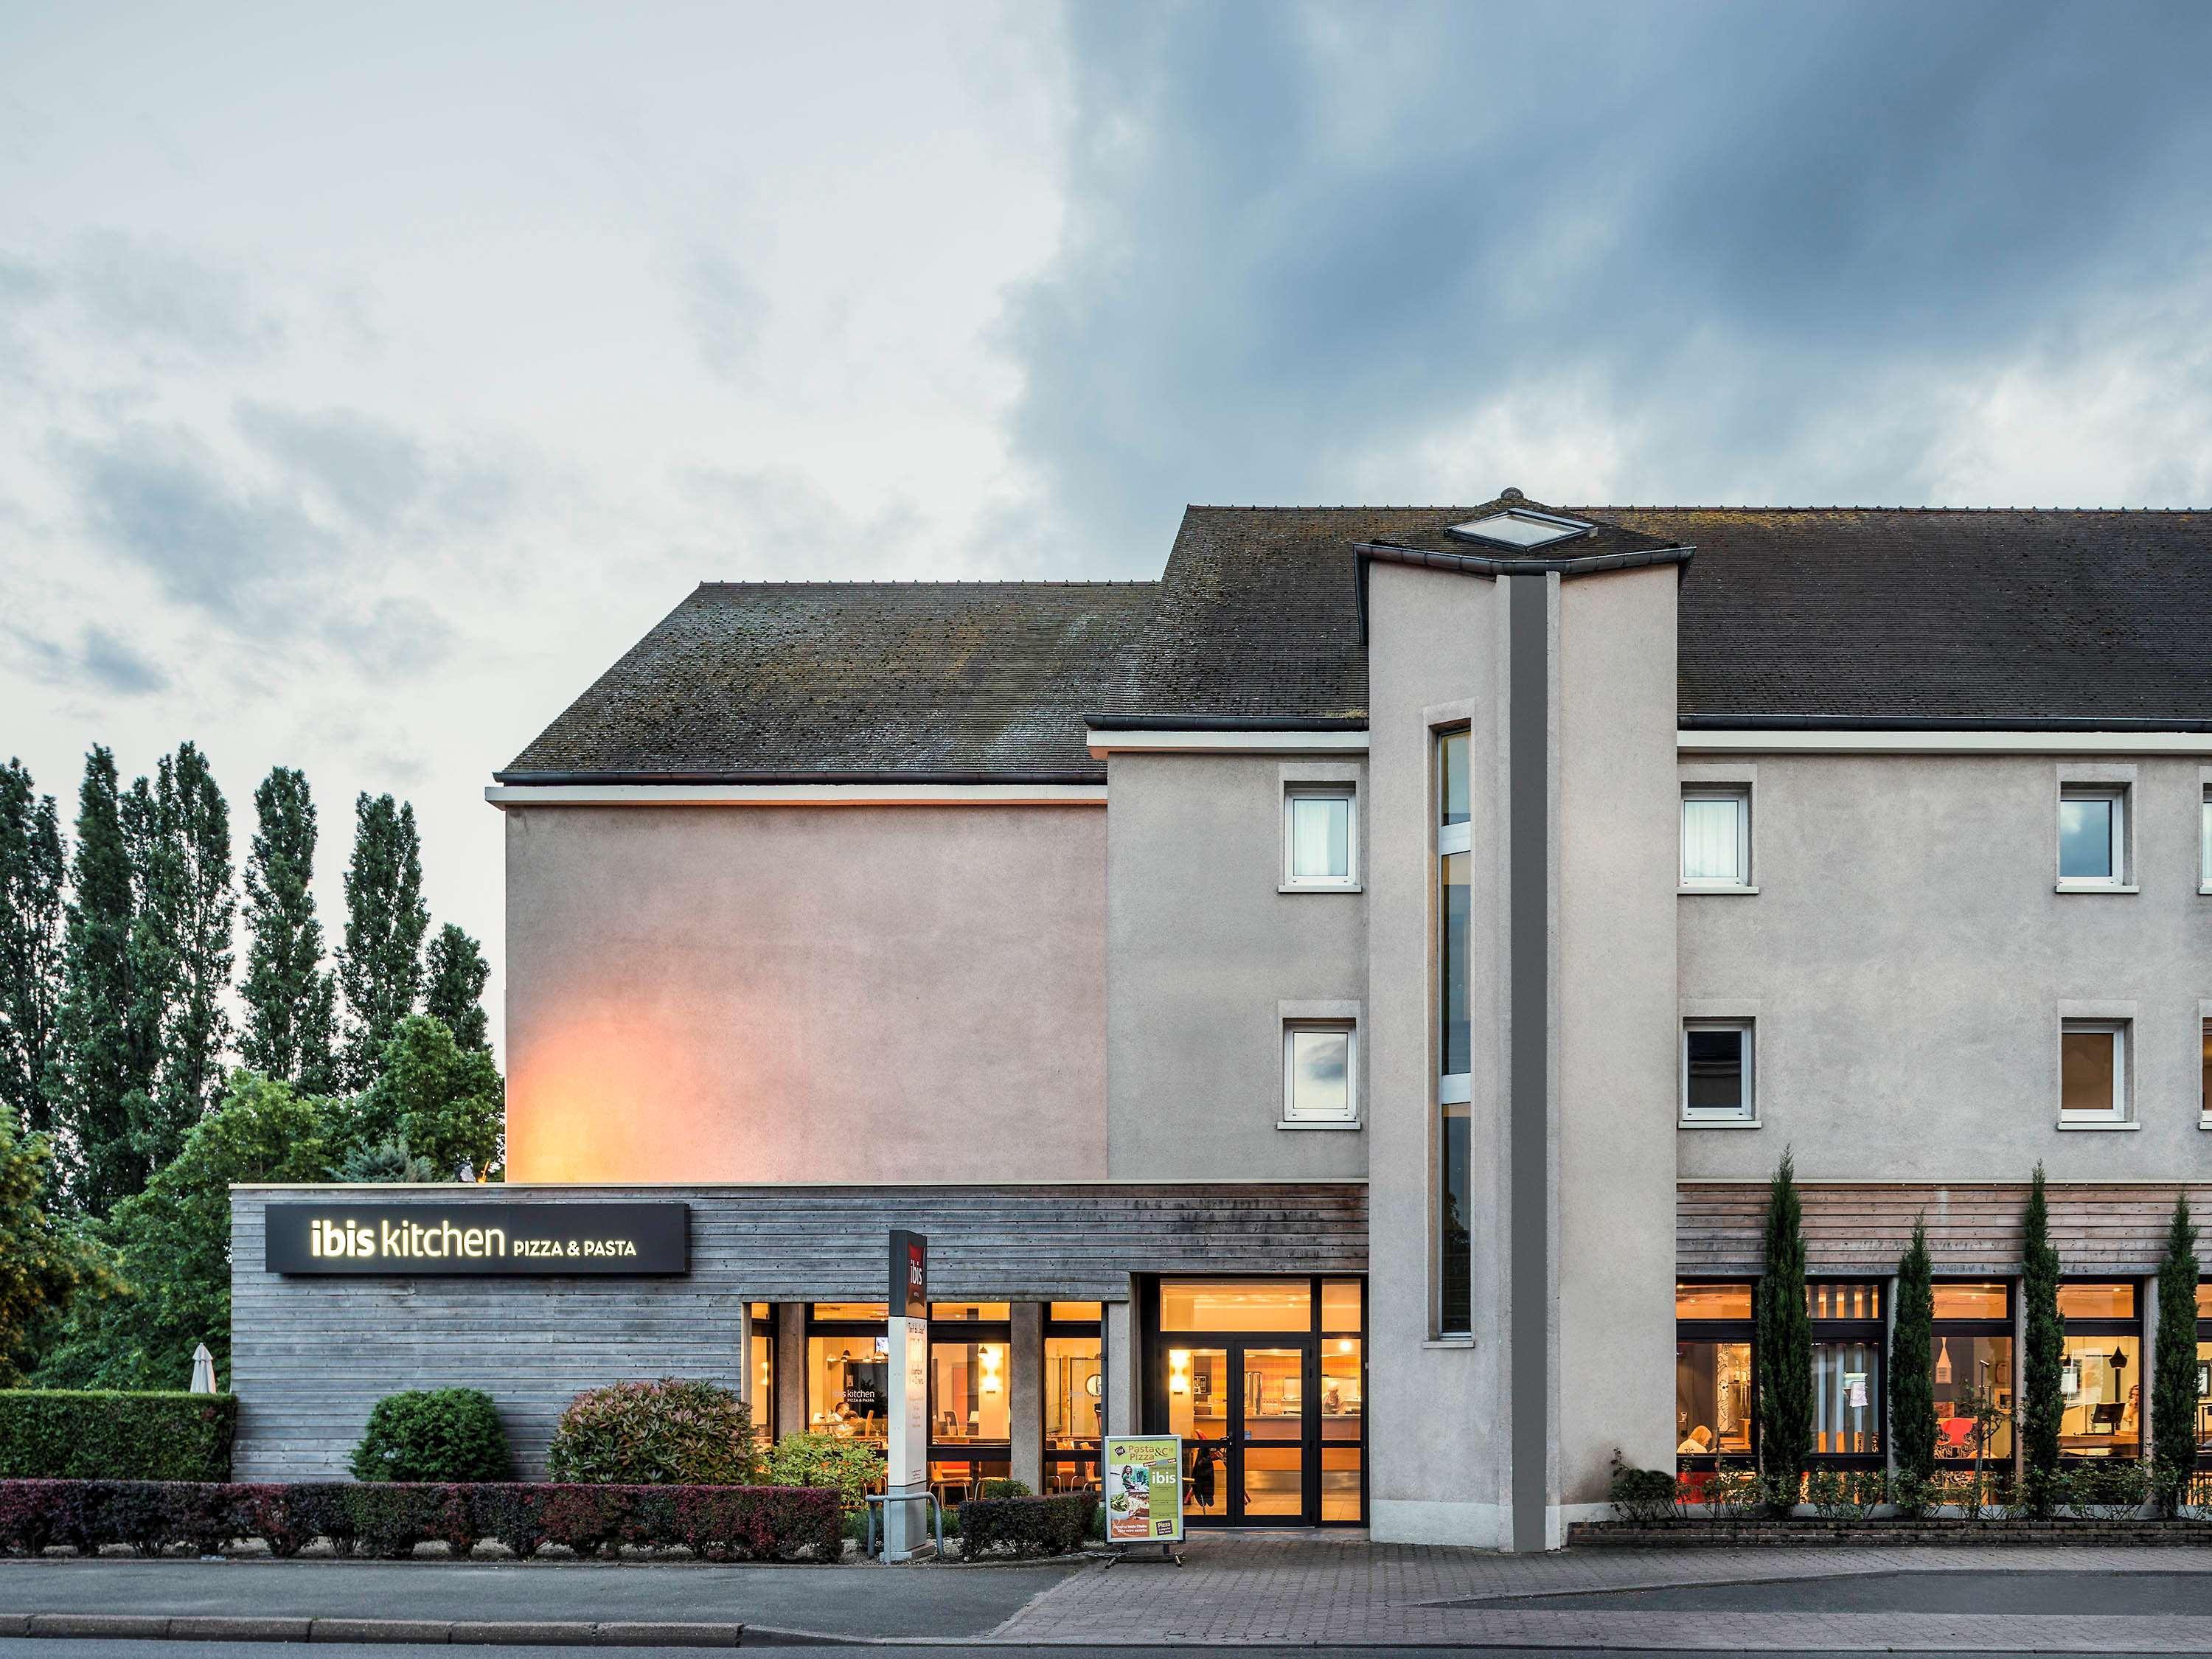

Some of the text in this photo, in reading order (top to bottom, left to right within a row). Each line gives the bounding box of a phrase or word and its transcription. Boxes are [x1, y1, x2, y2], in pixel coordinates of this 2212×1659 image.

[311, 1220, 637, 1257] ibis kitchen PIZZA & PASTA
[911, 1259, 922, 1286] ibis
[847, 1389, 875, 1398] kitchen
[1130, 1453, 1155, 1461] Pizza
[1152, 1471, 1177, 1484] ibis
